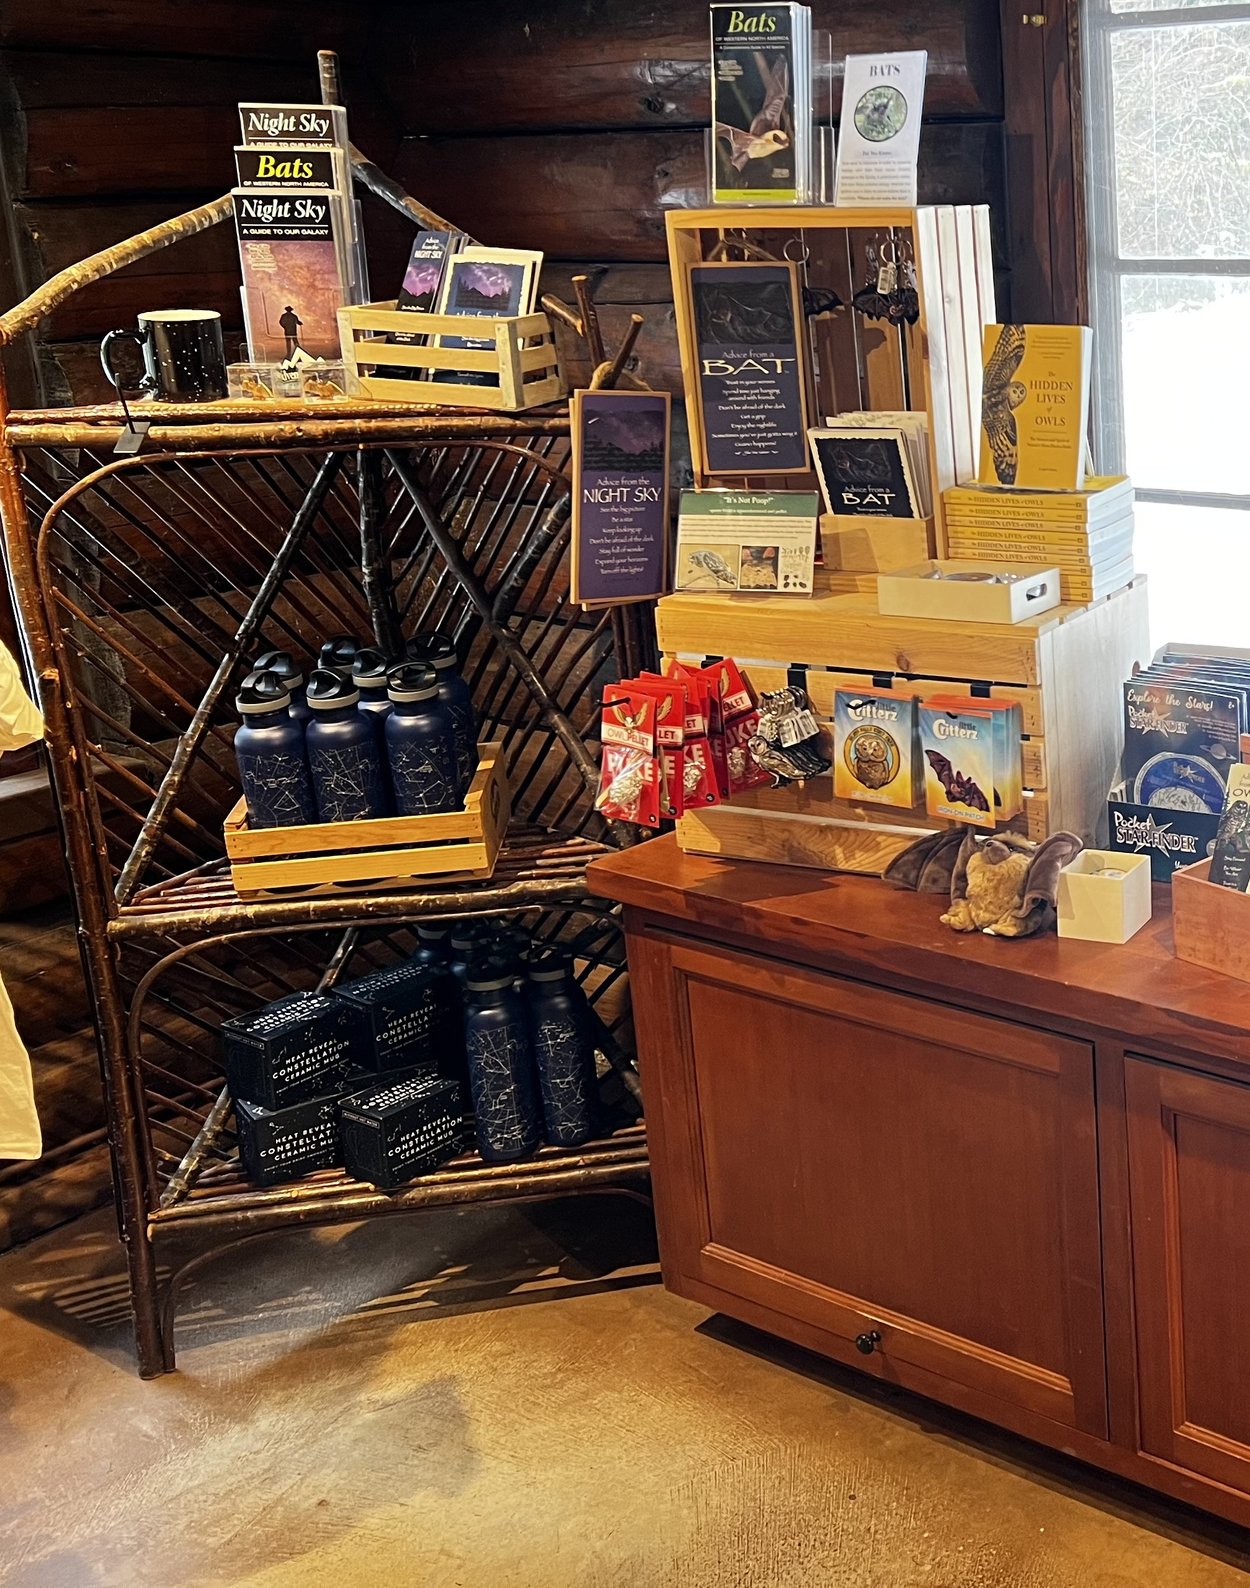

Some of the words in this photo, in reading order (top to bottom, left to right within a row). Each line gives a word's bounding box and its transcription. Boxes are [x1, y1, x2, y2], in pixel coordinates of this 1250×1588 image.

[728, 10, 776, 33] Bats
[869, 64, 901, 77] BATS
[248, 113, 296, 136] Night
[299, 114, 330, 136] Sky
[256, 155, 313, 179] Bats
[241, 199, 291, 223] Night
[294, 199, 326, 223] Sky
[722, 349, 748, 359] Advice
[749, 349, 770, 358] from
[702, 358, 796, 376] BAT
[1030, 380, 1073, 391] HIDDEN
[1036, 394, 1066, 404] LIVES
[1035, 416, 1066, 426] OWLS
[597, 476, 620, 486] Advice
[621, 476, 638, 485] from
[638, 476, 651, 485] the
[583, 487, 631, 503] NIGHT
[633, 487, 662, 503] SKY
[841, 492, 896, 505] BAT
[848, 698, 898, 722] Critterz
[1127, 688, 1160, 705] Explore
[1165, 694, 1181, 706] the
[1185, 696, 1214, 712] Stars!
[932, 718, 978, 740] Critterz
[1113, 811, 1152, 830] Pocket
[388, 1016, 407, 1028] HEAT
[388, 1026, 422, 1045] CERAMIC
[272, 1040, 350, 1079] CONSTELLATION
[285, 1051, 306, 1065] HEAT
[308, 1038, 337, 1055] REVEAL
[285, 1062, 320, 1082] CERAMIC
[323, 1053, 340, 1065] MUG
[275, 1132, 299, 1145] HEAT
[302, 1121, 337, 1136] REVEAL
[388, 1116, 463, 1157] CONSTELLATION
[401, 1128, 420, 1142] HEAT
[422, 1115, 451, 1132] REVEAL
[260, 1130, 331, 1157] CONSTELLAT
[274, 1143, 316, 1161] CERAMIC
[400, 1139, 435, 1160] CERAMIC
[437, 1130, 454, 1142] MUG
